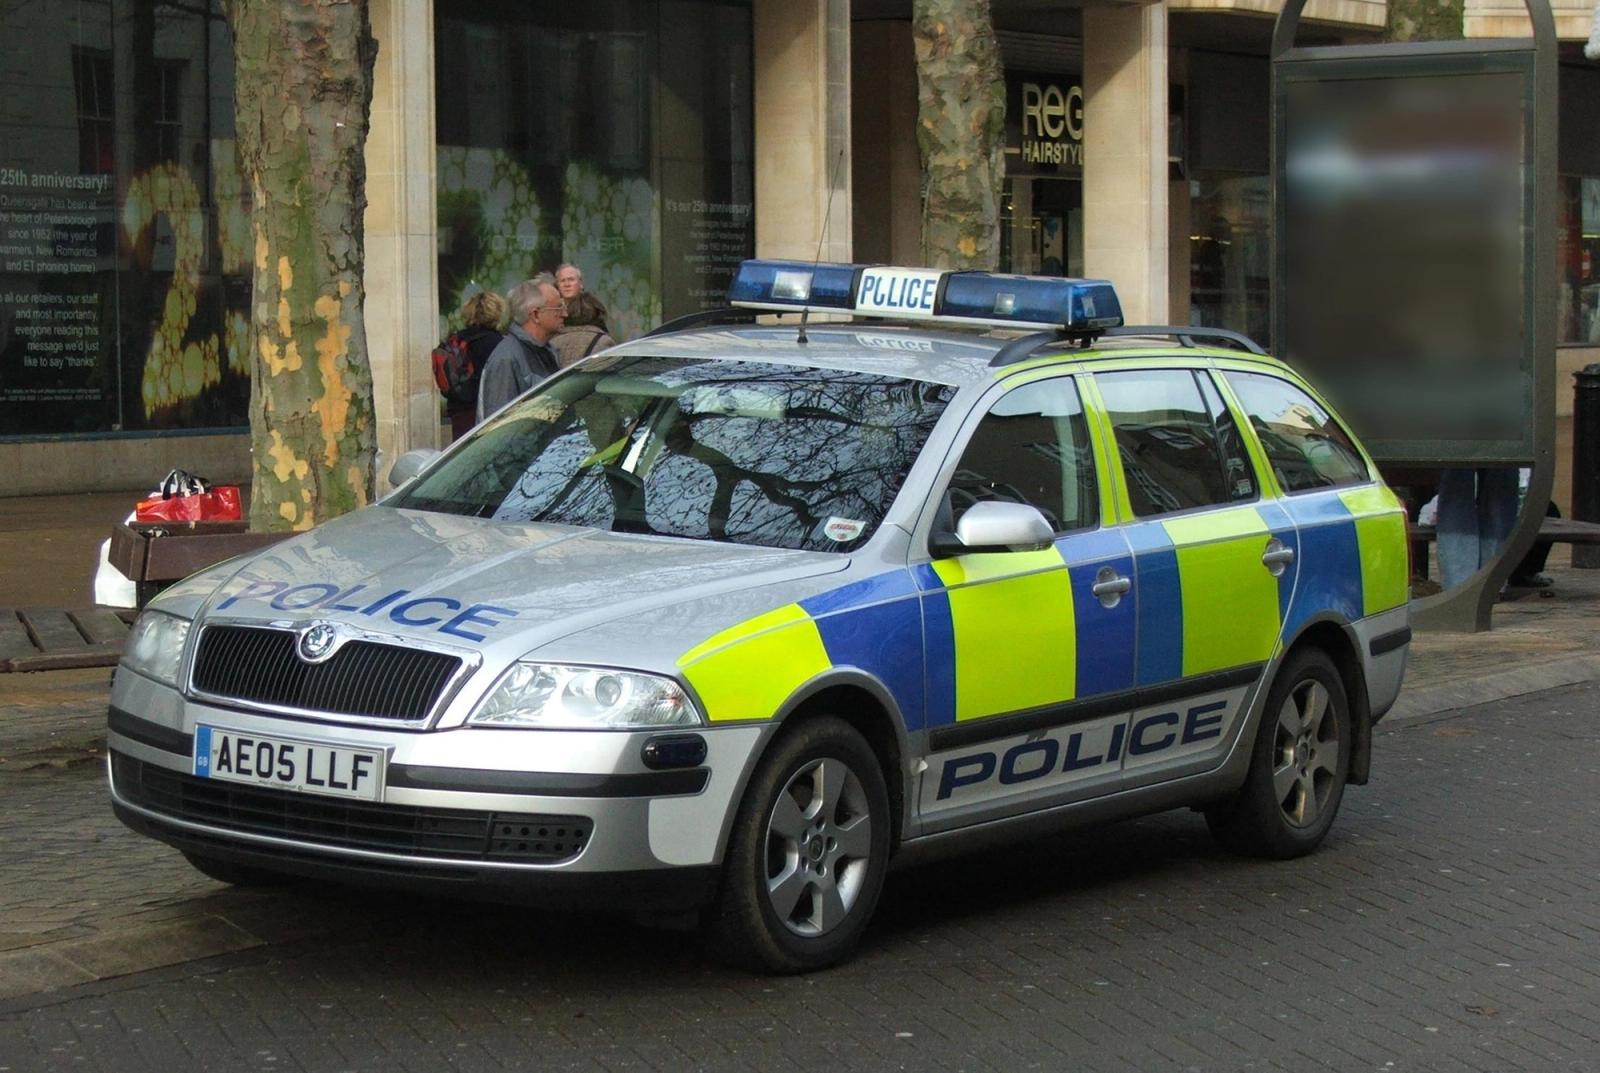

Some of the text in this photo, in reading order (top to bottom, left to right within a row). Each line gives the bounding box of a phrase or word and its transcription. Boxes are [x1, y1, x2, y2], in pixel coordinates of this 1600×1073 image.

[0, 168, 107, 194] 25th anniversary!
[34, 213, 41, 224] of
[44, 213, 96, 227] Peterborough
[8, 230, 29, 239] since
[70, 232, 88, 243] year
[89, 230, 97, 241] of
[56, 245, 97, 257] Romantics
[6, 260, 21, 271] and
[24, 260, 34, 271] ET
[37, 262, 68, 273] phoning
[16, 294, 28, 303] our
[31, 293, 65, 304] retailers,
[67, 295, 80, 303] our
[82, 293, 98, 303] staff
[859, 275, 937, 309] POLICE
[16, 308, 97, 322] and most importantly,
[15, 325, 98, 337] everyone reading this
[28, 340, 99, 353] message we'd just
[24, 355, 38, 367] like
[40, 356, 47, 367] to
[49, 358, 63, 369] say
[216, 582, 520, 643] POLICE
[936, 700, 1227, 800] POLICE
[216, 735, 373, 791] AE05 LLF
